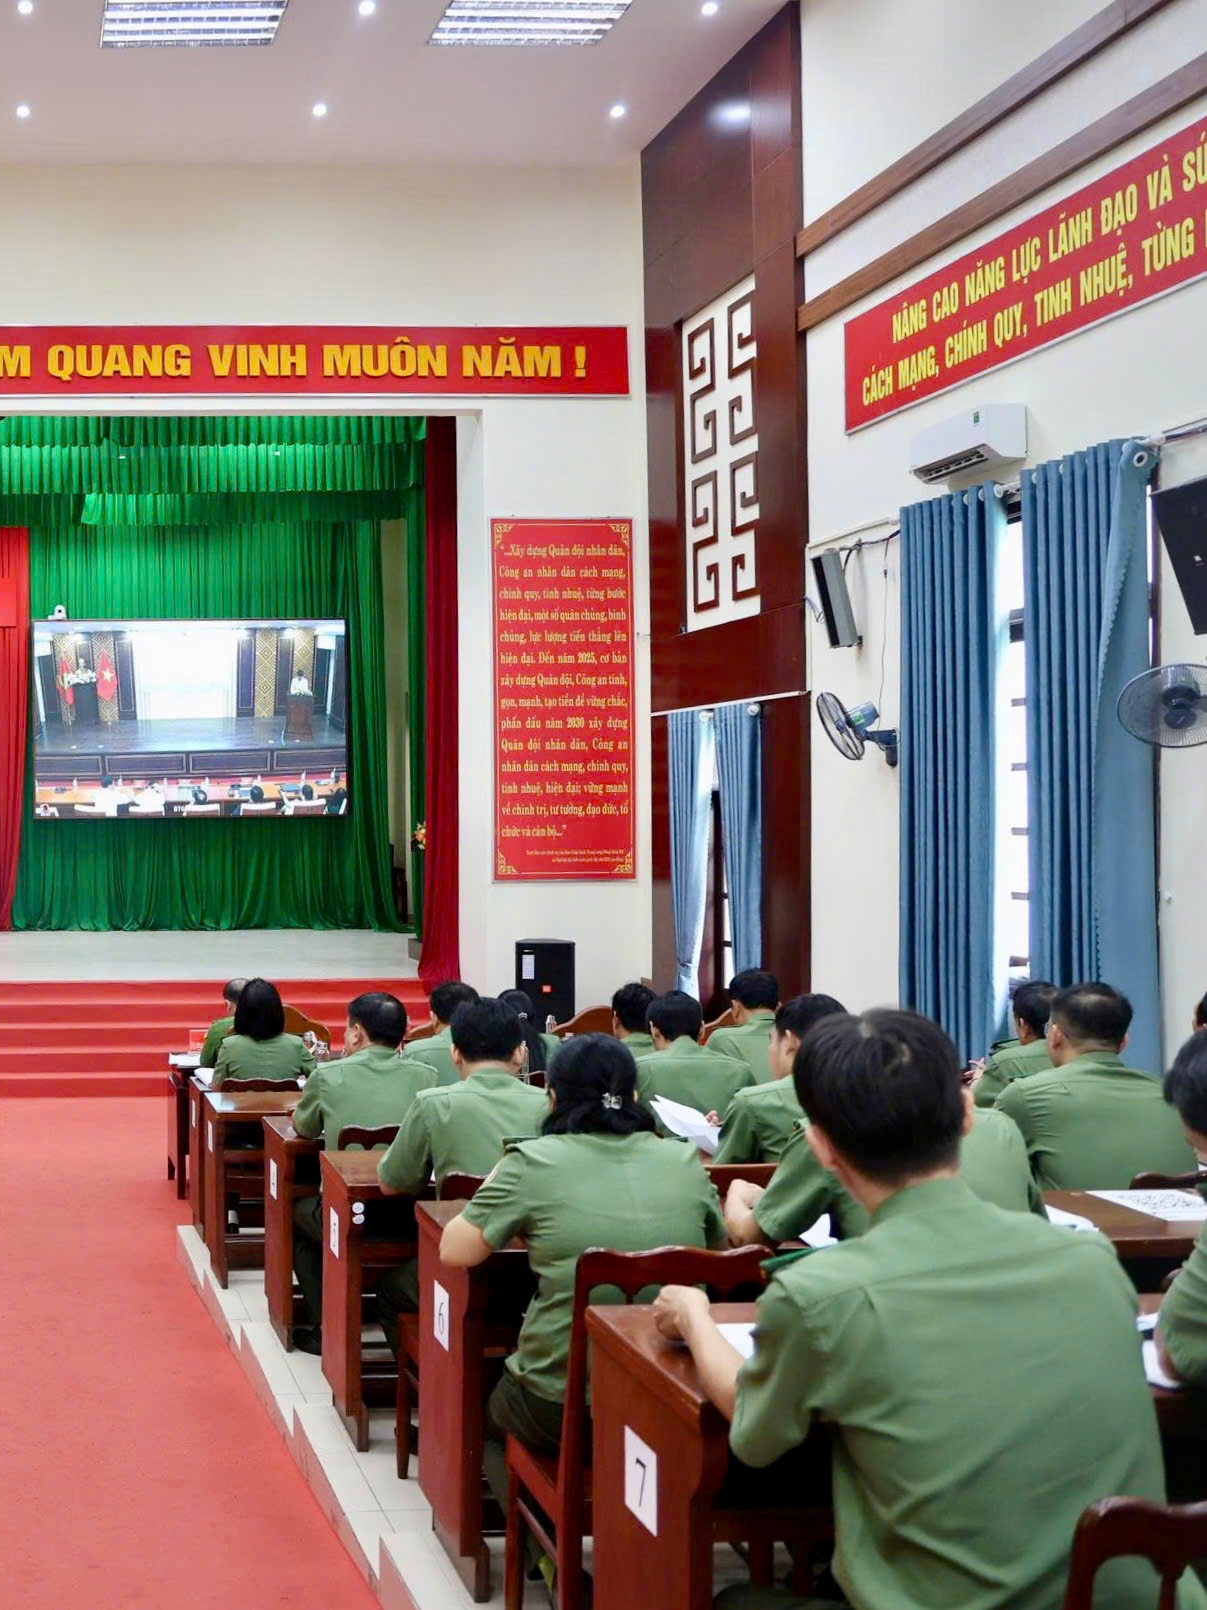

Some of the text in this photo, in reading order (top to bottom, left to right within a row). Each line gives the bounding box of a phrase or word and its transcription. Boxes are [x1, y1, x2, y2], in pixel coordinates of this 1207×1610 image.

[893, 299, 927, 342] NÂNG
[933, 282, 959, 322] CAO
[965, 256, 1005, 305] NĂNG
[1012, 237, 1041, 283] LỰC
[1049, 208, 1092, 261] LÃNH
[1101, 184, 1137, 235] ĐẠO
[1147, 154, 1173, 211] VÀ
[863, 360, 893, 406] CÁCH
[898, 346, 939, 389] MẠNG,
[945, 320, 987, 368] CHÍNH
[994, 303, 1027, 348] QUY,
[1034, 278, 1071, 326] TINH
[1080, 244, 1133, 304] NHUỆ,
[1142, 218, 1194, 274] TỪNG
[48, 345, 190, 380] QUANG
[208, 345, 306, 375] VINH
[324, 337, 447, 376] MUÔN
[463, 338, 560, 376] NĂM
[576, 347, 585, 376] !
[438, 1302, 444, 1335] 6
[636, 1458, 646, 1507] 7
